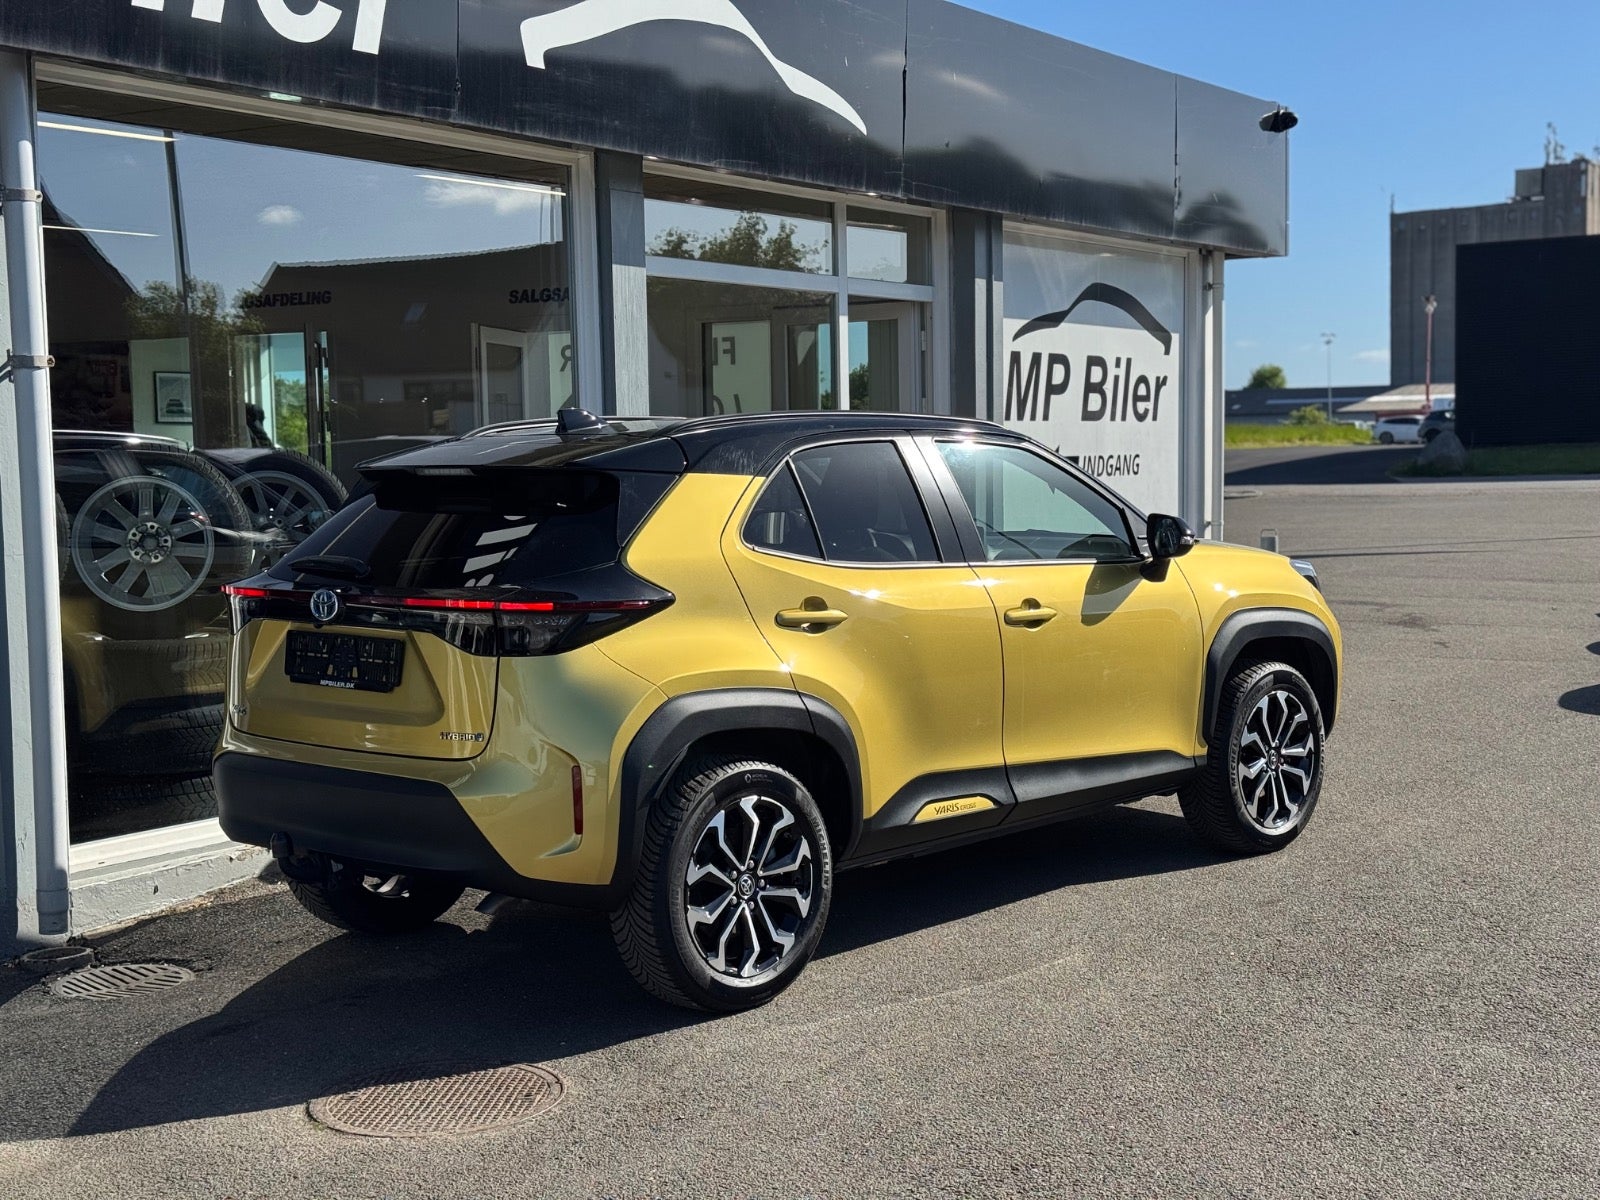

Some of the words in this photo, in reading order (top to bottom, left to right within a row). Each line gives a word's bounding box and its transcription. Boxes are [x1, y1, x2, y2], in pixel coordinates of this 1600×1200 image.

[243, 290, 332, 309] GSAFDELING
[1004, 351, 1071, 421] MP
[1081, 355, 1168, 422] Biler
[1083, 454, 1140, 477] INDGANG
[934, 803, 960, 815] YARIS
[811, 815, 831, 887] MICHELIN
